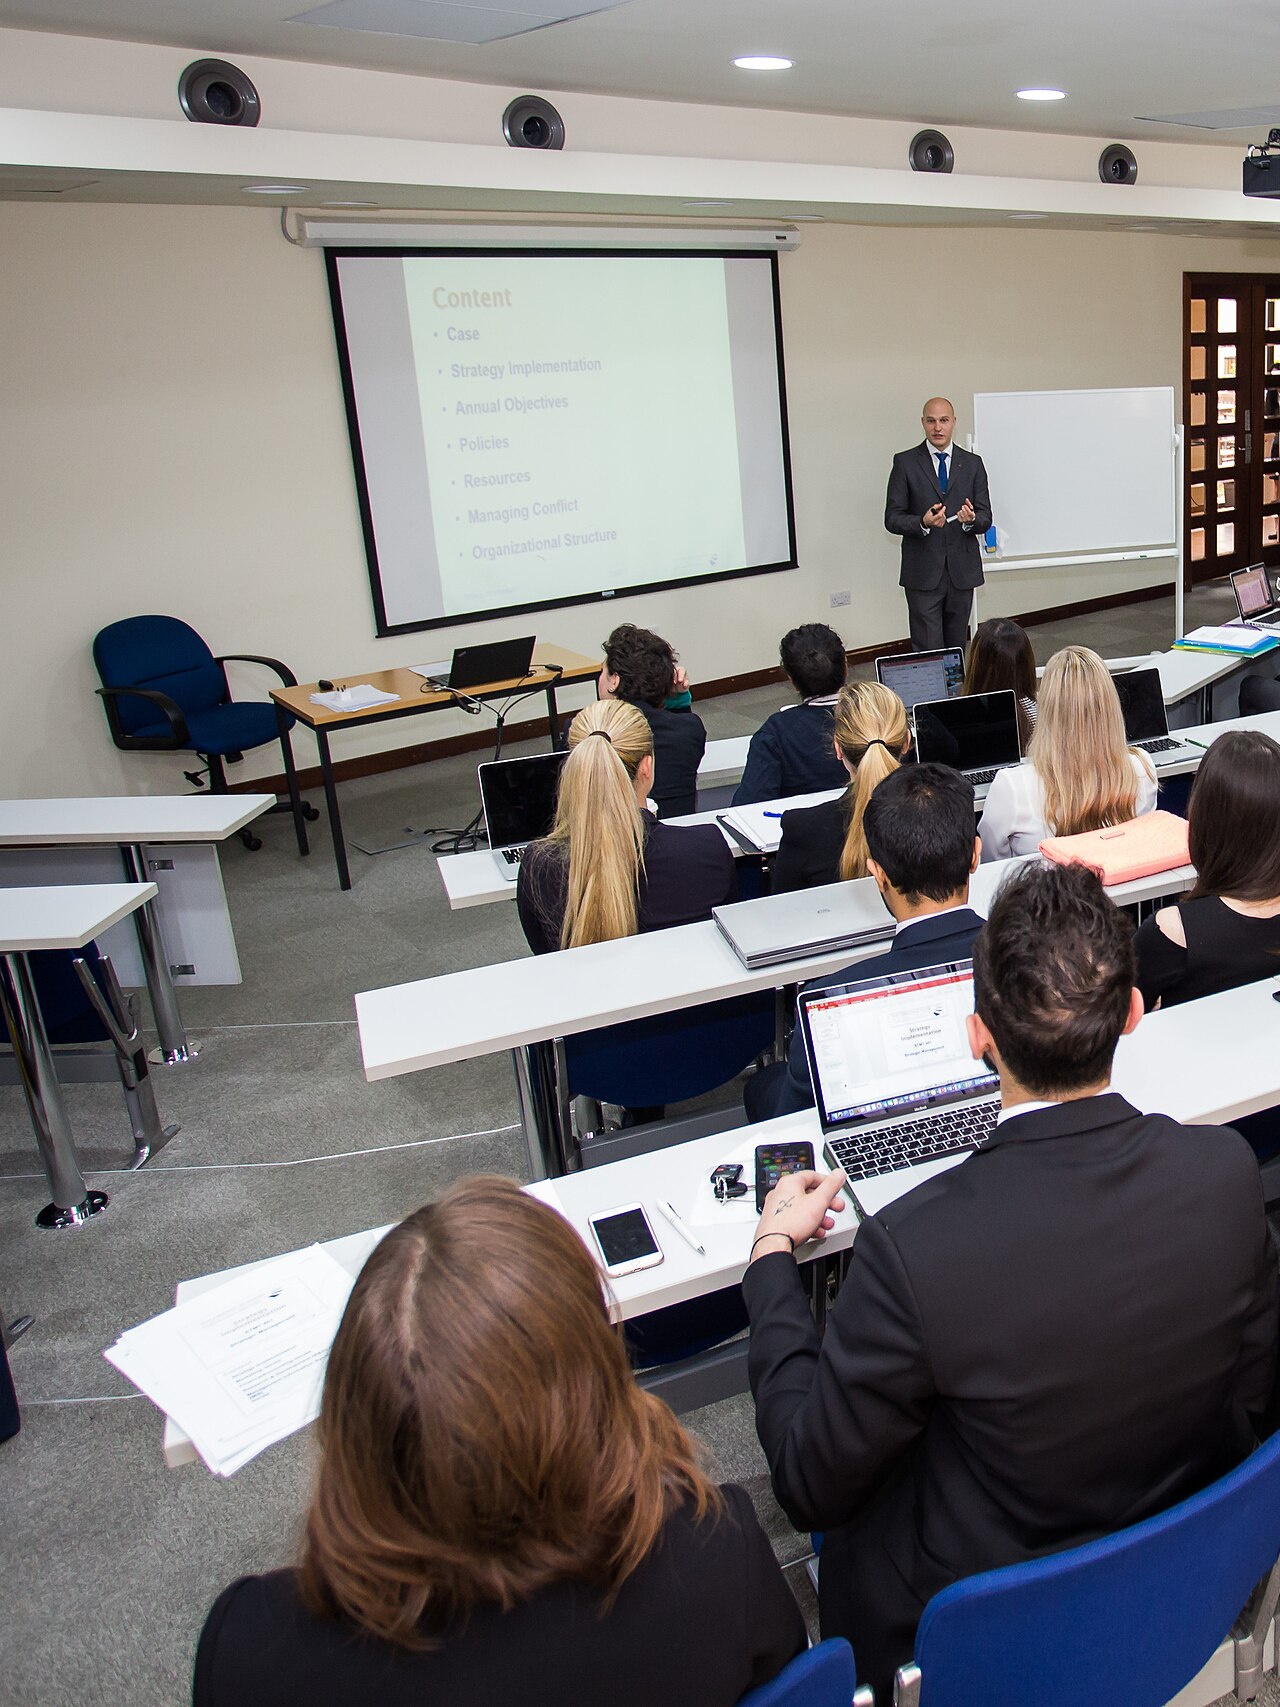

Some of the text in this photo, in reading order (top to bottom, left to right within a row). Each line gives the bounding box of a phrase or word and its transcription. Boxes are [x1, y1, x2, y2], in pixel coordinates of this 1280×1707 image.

[432, 286, 513, 310] Content
[447, 326, 480, 342] Case
[451, 357, 602, 380] Strategy Implementation
[455, 395, 569, 416] Annual Objectives
[459, 435, 510, 452] Policies
[463, 471, 532, 489] Resources
[467, 499, 579, 524] Managing Conflict
[472, 530, 618, 561] Organizational Structure
